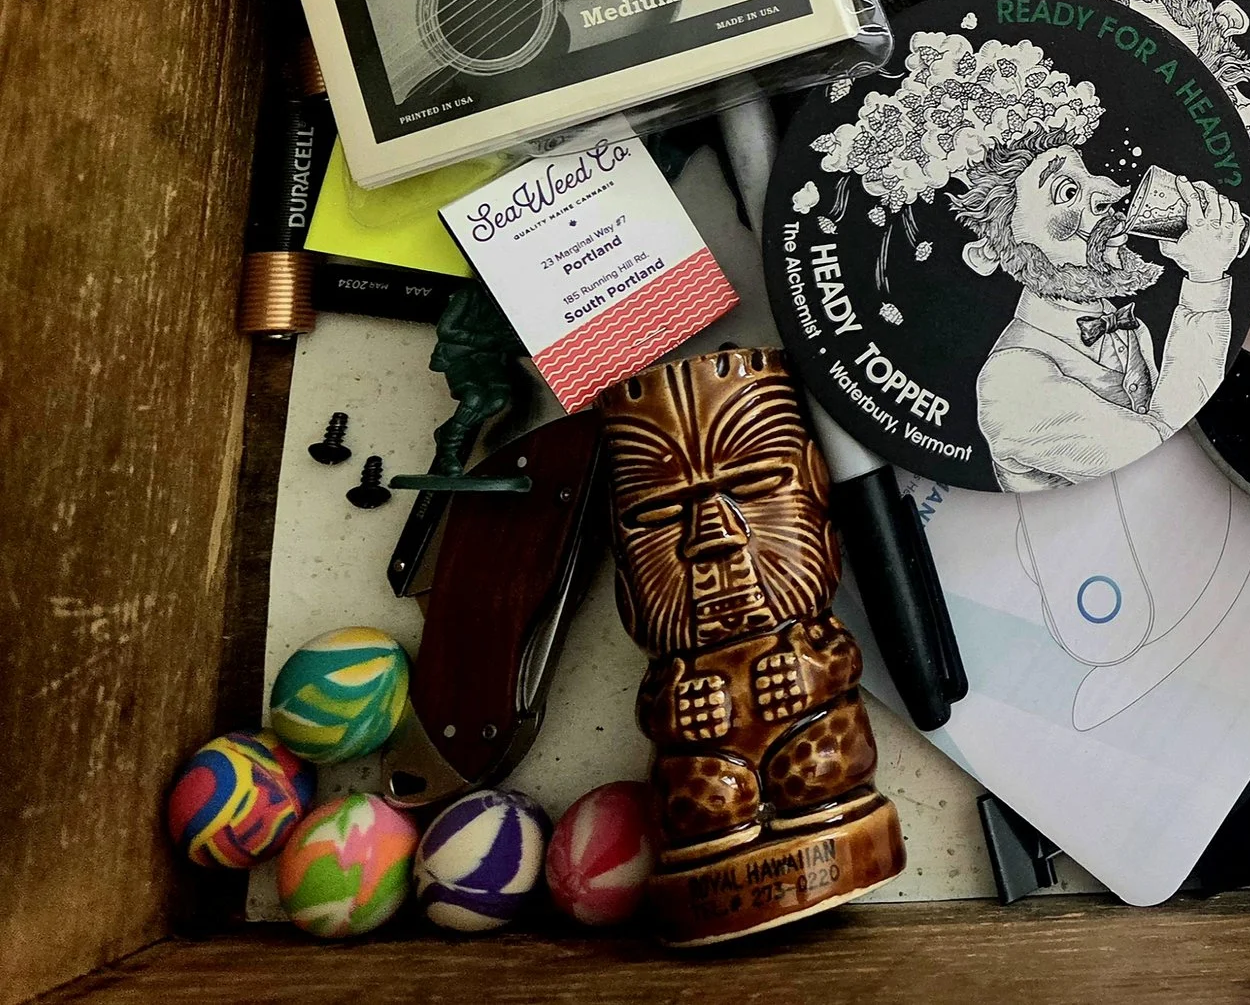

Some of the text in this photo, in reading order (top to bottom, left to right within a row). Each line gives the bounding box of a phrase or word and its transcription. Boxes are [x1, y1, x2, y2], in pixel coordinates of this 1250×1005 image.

[716, 5, 780, 30] MADE IN USA
[399, 96, 474, 125] PRINTED IN USA
[1097, 16, 1157, 66] FOR
[1154, 59, 1179, 85] A
[1175, 77, 1243, 187] HEADY?
[288, 126, 315, 228] DURACELL
[587, 138, 632, 172] Co.
[513, 180, 615, 240] QUALITY MAINE CANNABIS
[541, 215, 627, 270] 23 Marginal Way #7
[563, 235, 623, 275] Portland
[338, 278, 369, 290] 2034
[563, 252, 650, 305] 185 Running Hill Rd.
[564, 258, 666, 324] South Portland
[783, 221, 973, 462] The Alchemist Waterbury, Vermont
[810, 243, 950, 427] HEADY TOPPER
[746, 839, 837, 885] HAWAIIAN
